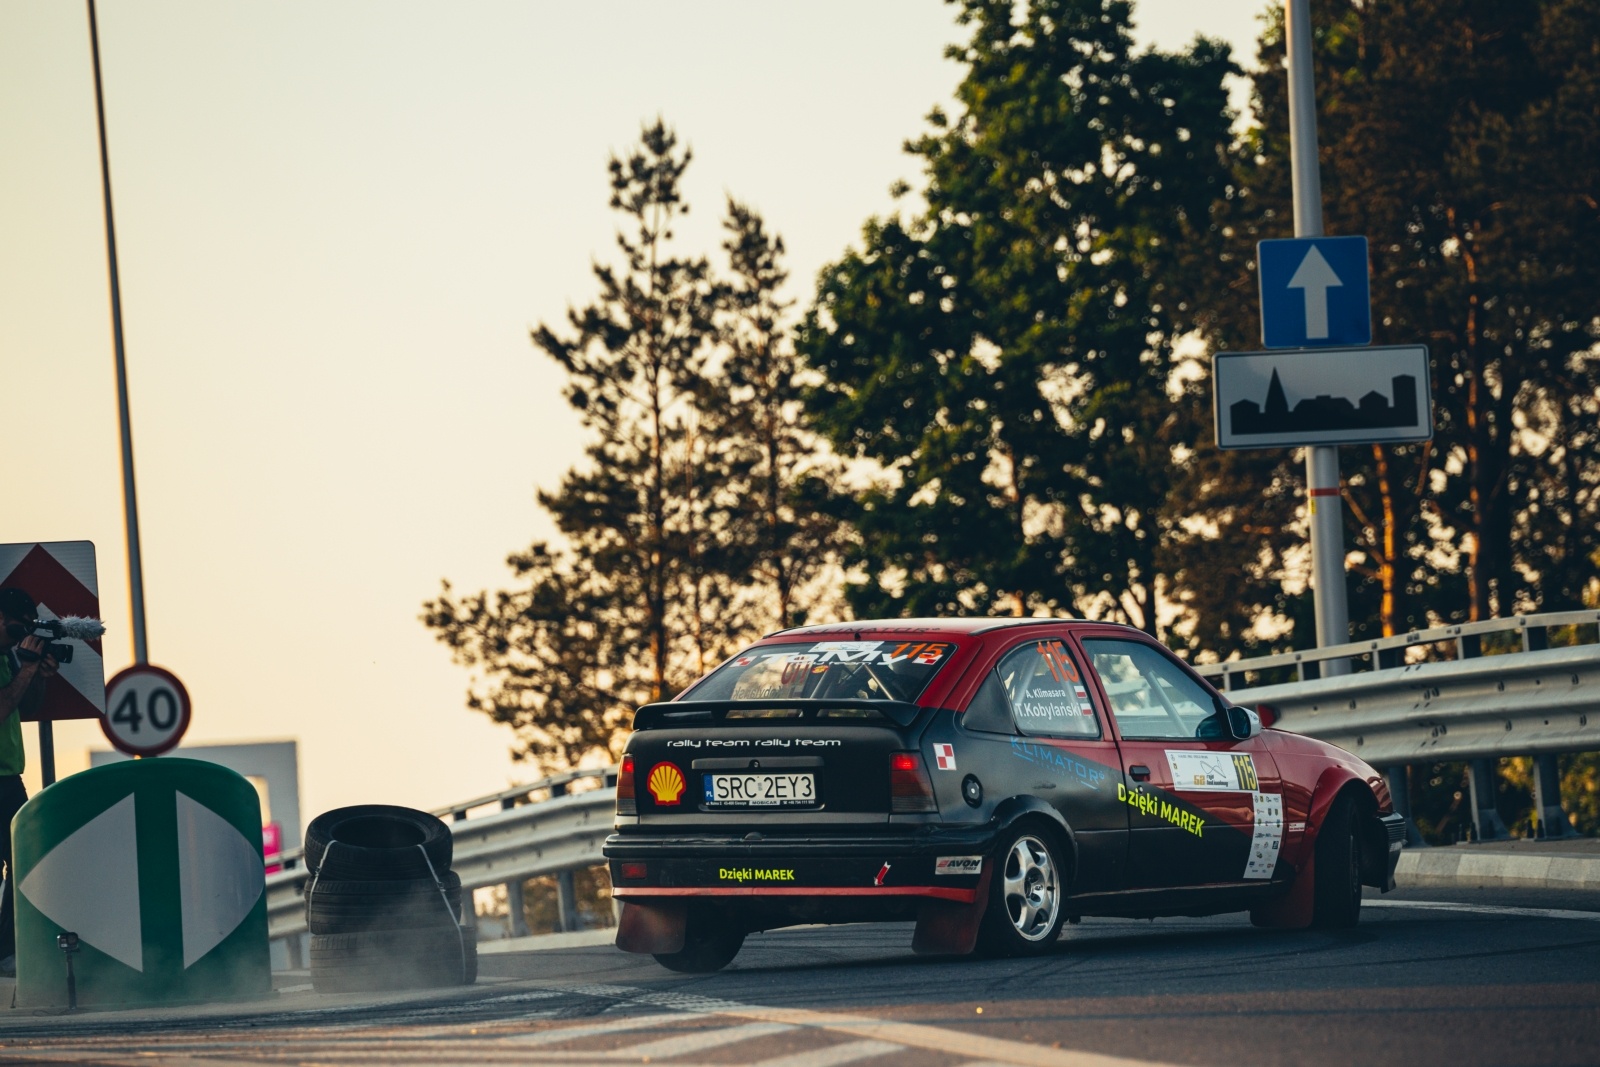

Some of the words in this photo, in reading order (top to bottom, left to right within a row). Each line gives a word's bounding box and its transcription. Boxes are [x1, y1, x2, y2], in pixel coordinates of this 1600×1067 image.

[889, 642, 949, 660] 115
[1037, 641, 1080, 683] 115
[1034, 688, 1066, 698] Klimasara
[112, 687, 178, 733] 40
[667, 739, 702, 748] rally
[706, 739, 750, 747] team
[755, 739, 791, 748] rally
[795, 738, 841, 747] team
[1233, 754, 1257, 790] 115
[716, 776, 757, 798] SRC
[764, 776, 812, 798] 2EY3
[1117, 783, 1158, 816] Dzięki
[1160, 801, 1205, 837] MAREK
[947, 860, 981, 868] AVON
[719, 868, 752, 882] Dzięki
[755, 868, 795, 880] MAREK
